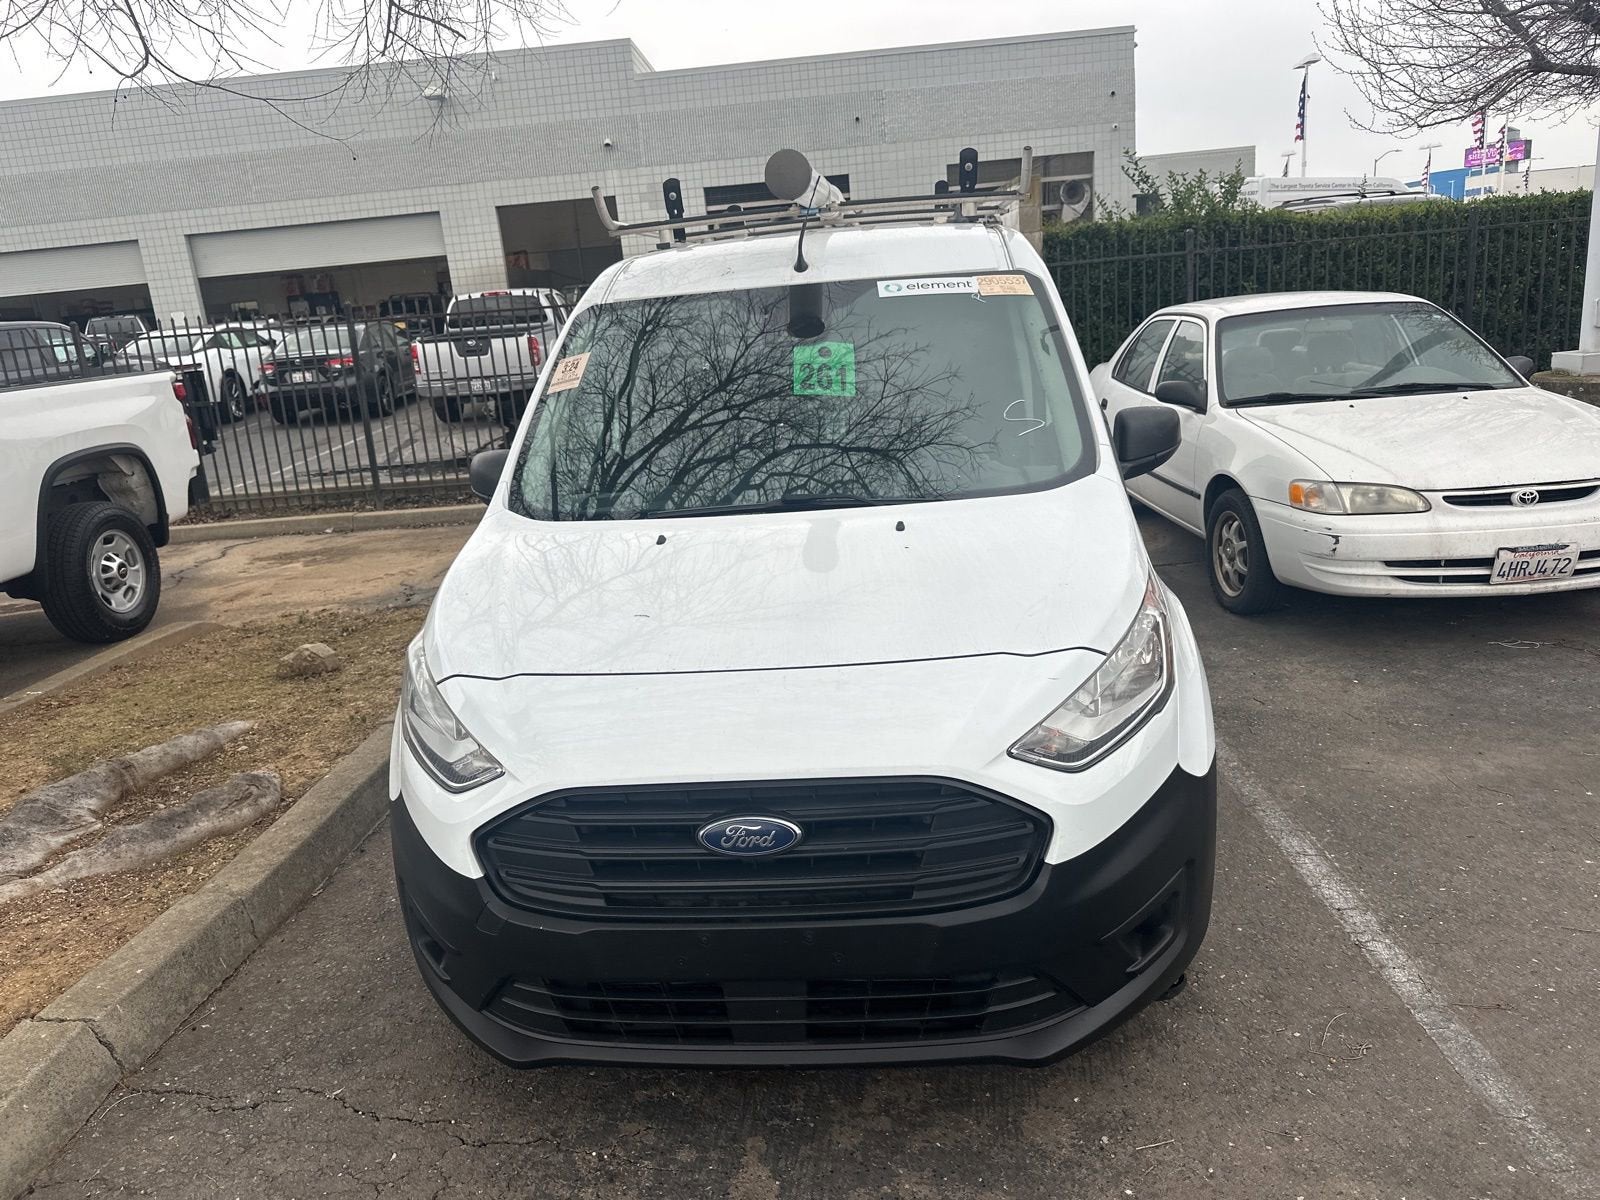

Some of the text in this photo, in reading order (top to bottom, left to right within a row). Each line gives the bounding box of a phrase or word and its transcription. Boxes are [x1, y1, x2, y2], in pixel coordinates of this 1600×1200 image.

[906, 280, 973, 291] element
[800, 363, 847, 391] 261
[1496, 557, 1572, 578] 4HRJ472
[720, 824, 776, 848] Ford
